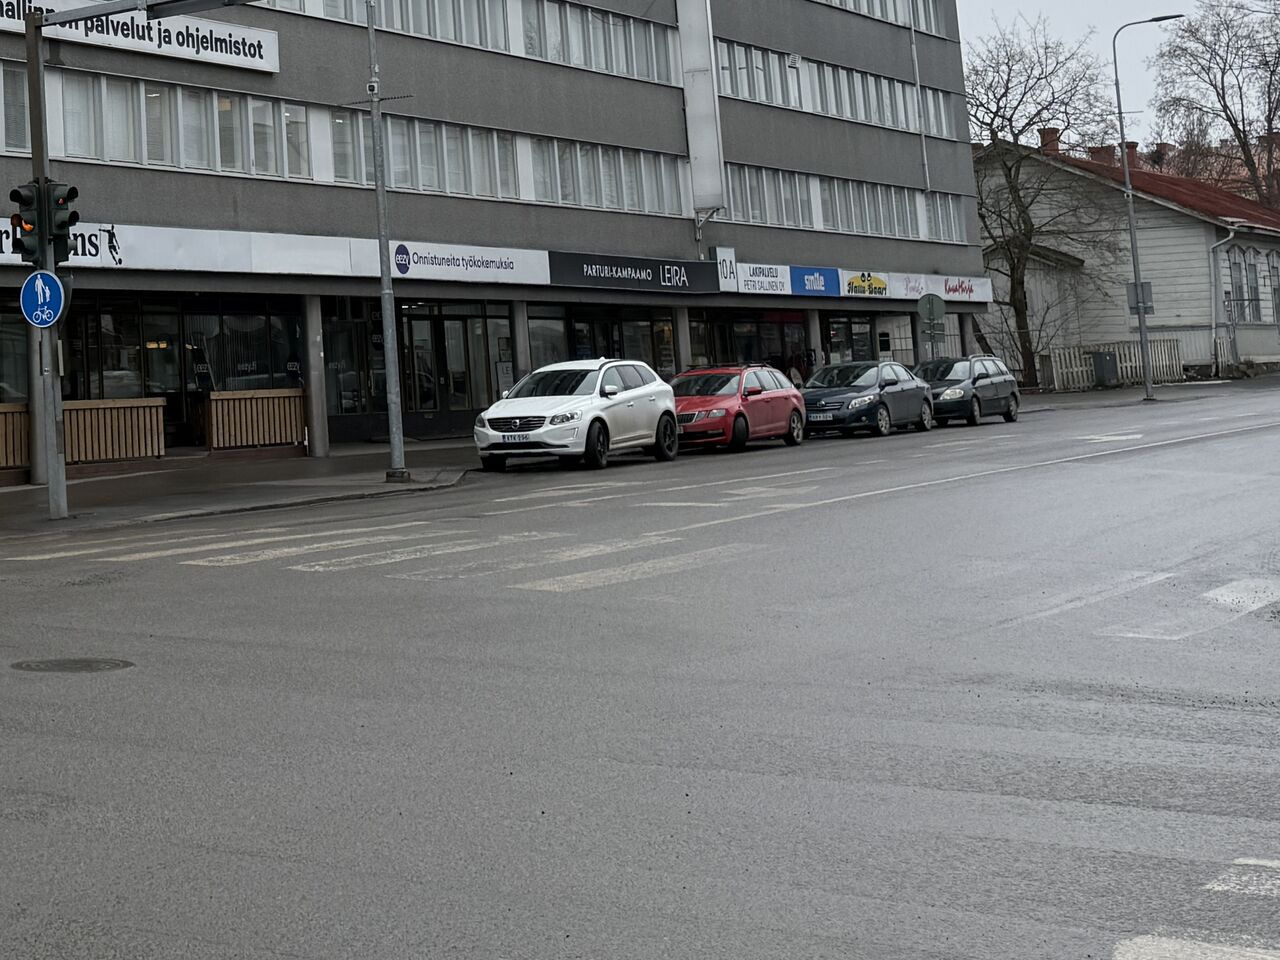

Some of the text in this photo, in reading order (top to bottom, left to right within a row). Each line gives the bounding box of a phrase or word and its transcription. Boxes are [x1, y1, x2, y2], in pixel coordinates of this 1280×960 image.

[83, 14, 153, 43] palvelut
[156, 20, 172, 49] ja
[176, 25, 264, 61] ohjelmistot
[412, 252, 461, 268] Onnistuneita
[461, 255, 514, 271] työkokemuksia
[719, 258, 736, 280] 10 A
[583, 264, 689, 287] PARTURI-KAMPAAMO LEIRA
